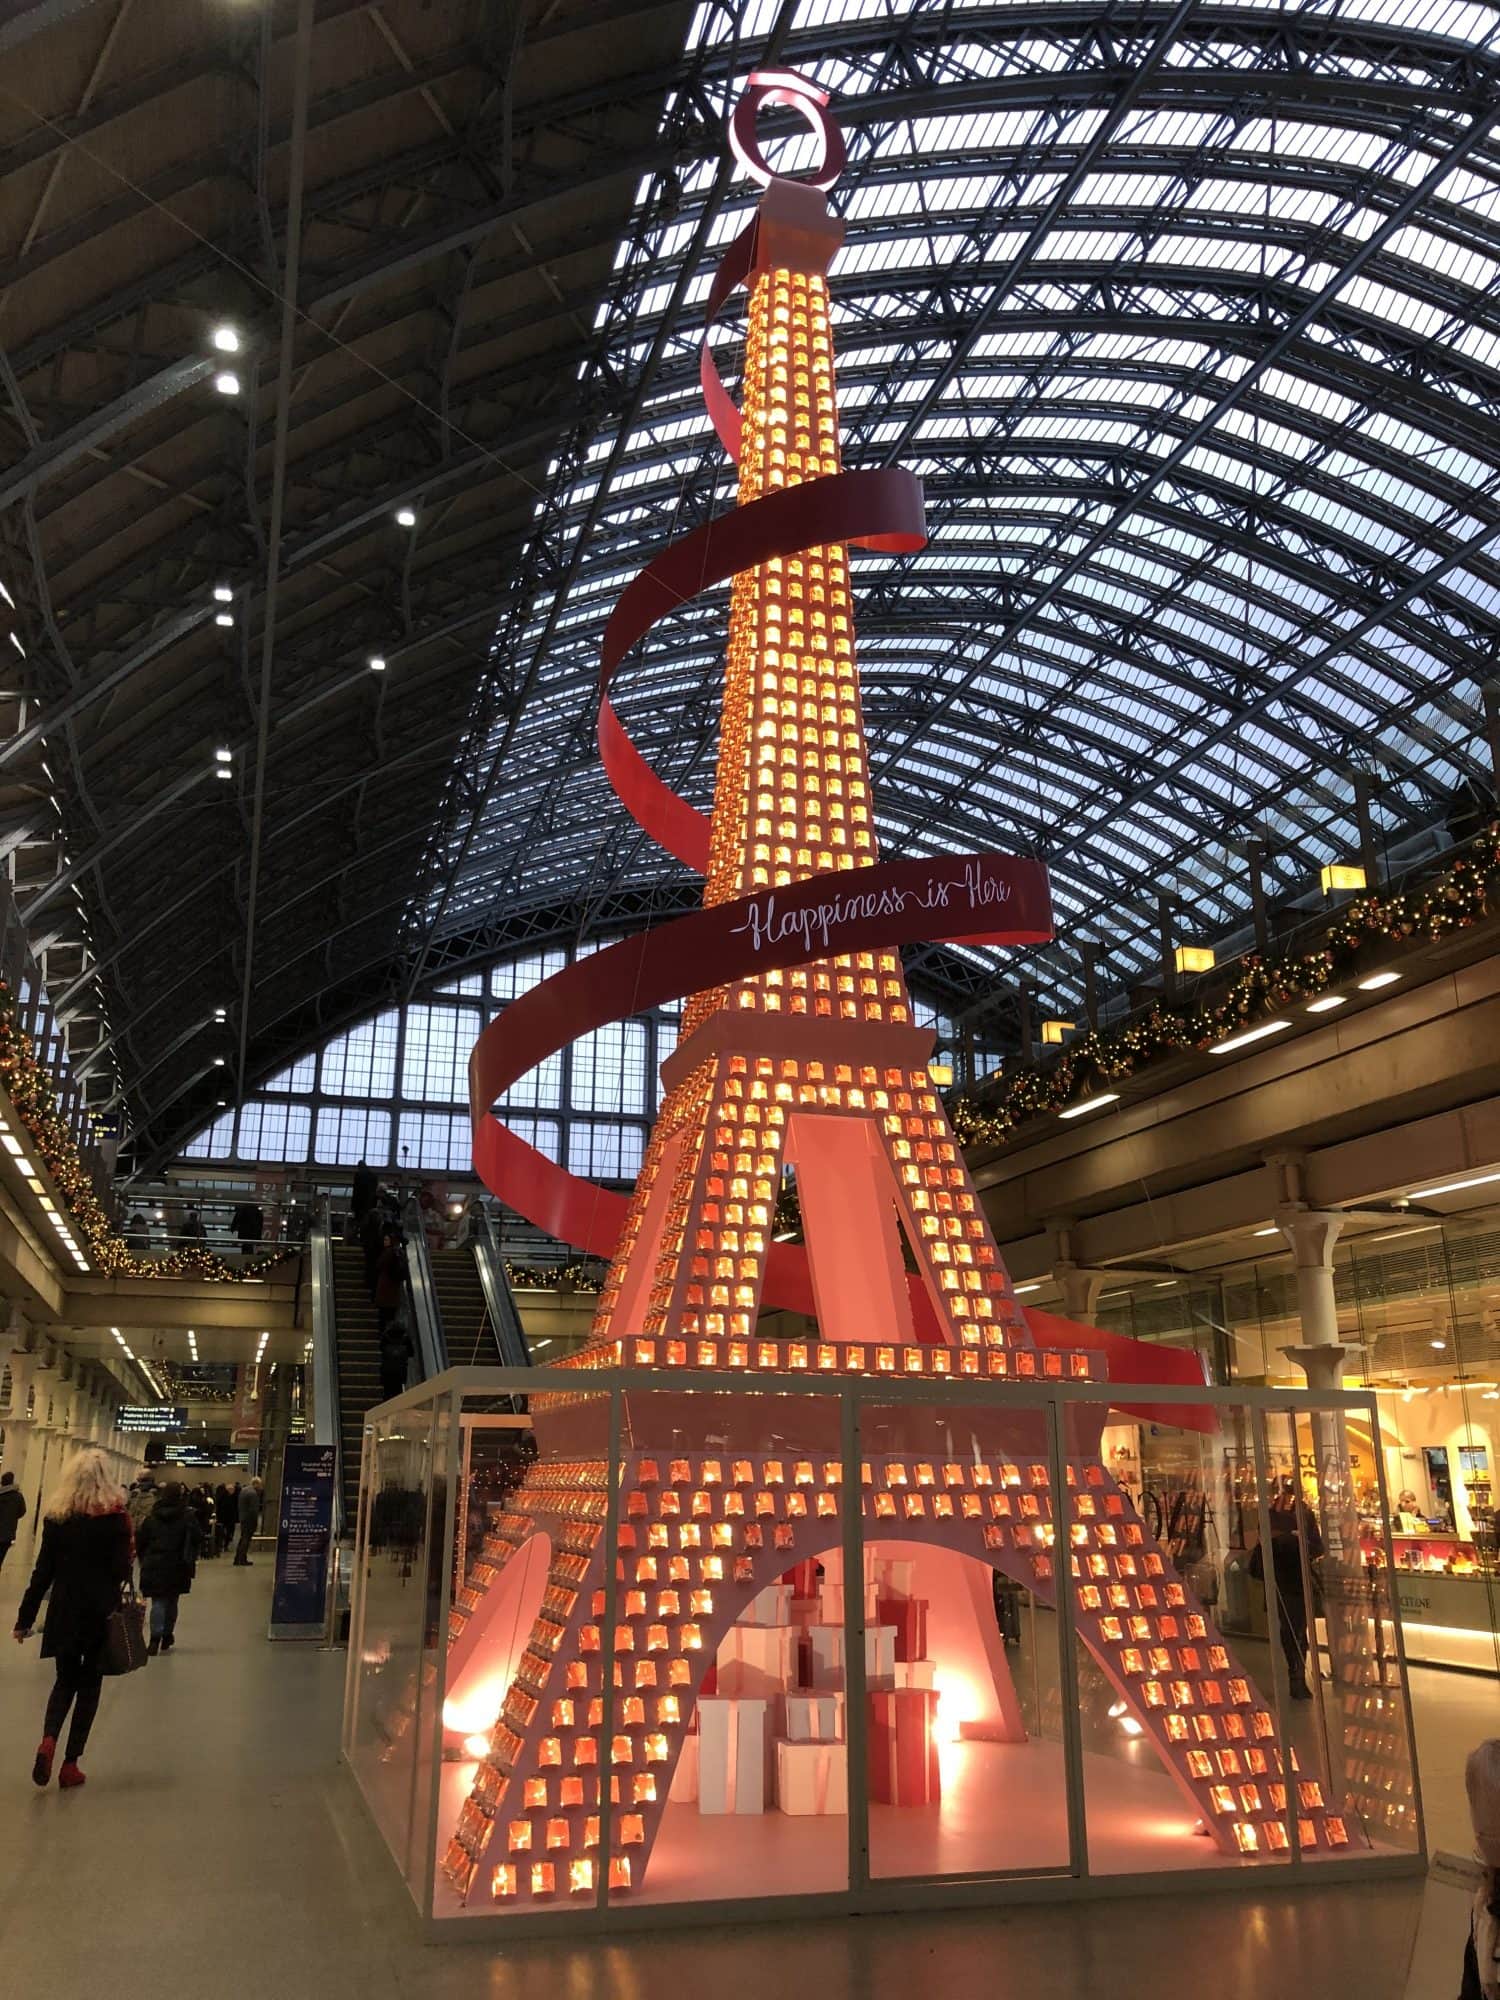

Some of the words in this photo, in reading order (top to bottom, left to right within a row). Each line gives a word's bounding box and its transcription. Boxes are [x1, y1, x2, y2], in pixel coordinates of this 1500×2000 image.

[729, 886, 908, 951] Happiness
[917, 878, 949, 908] is
[964, 859, 1011, 909] Here
